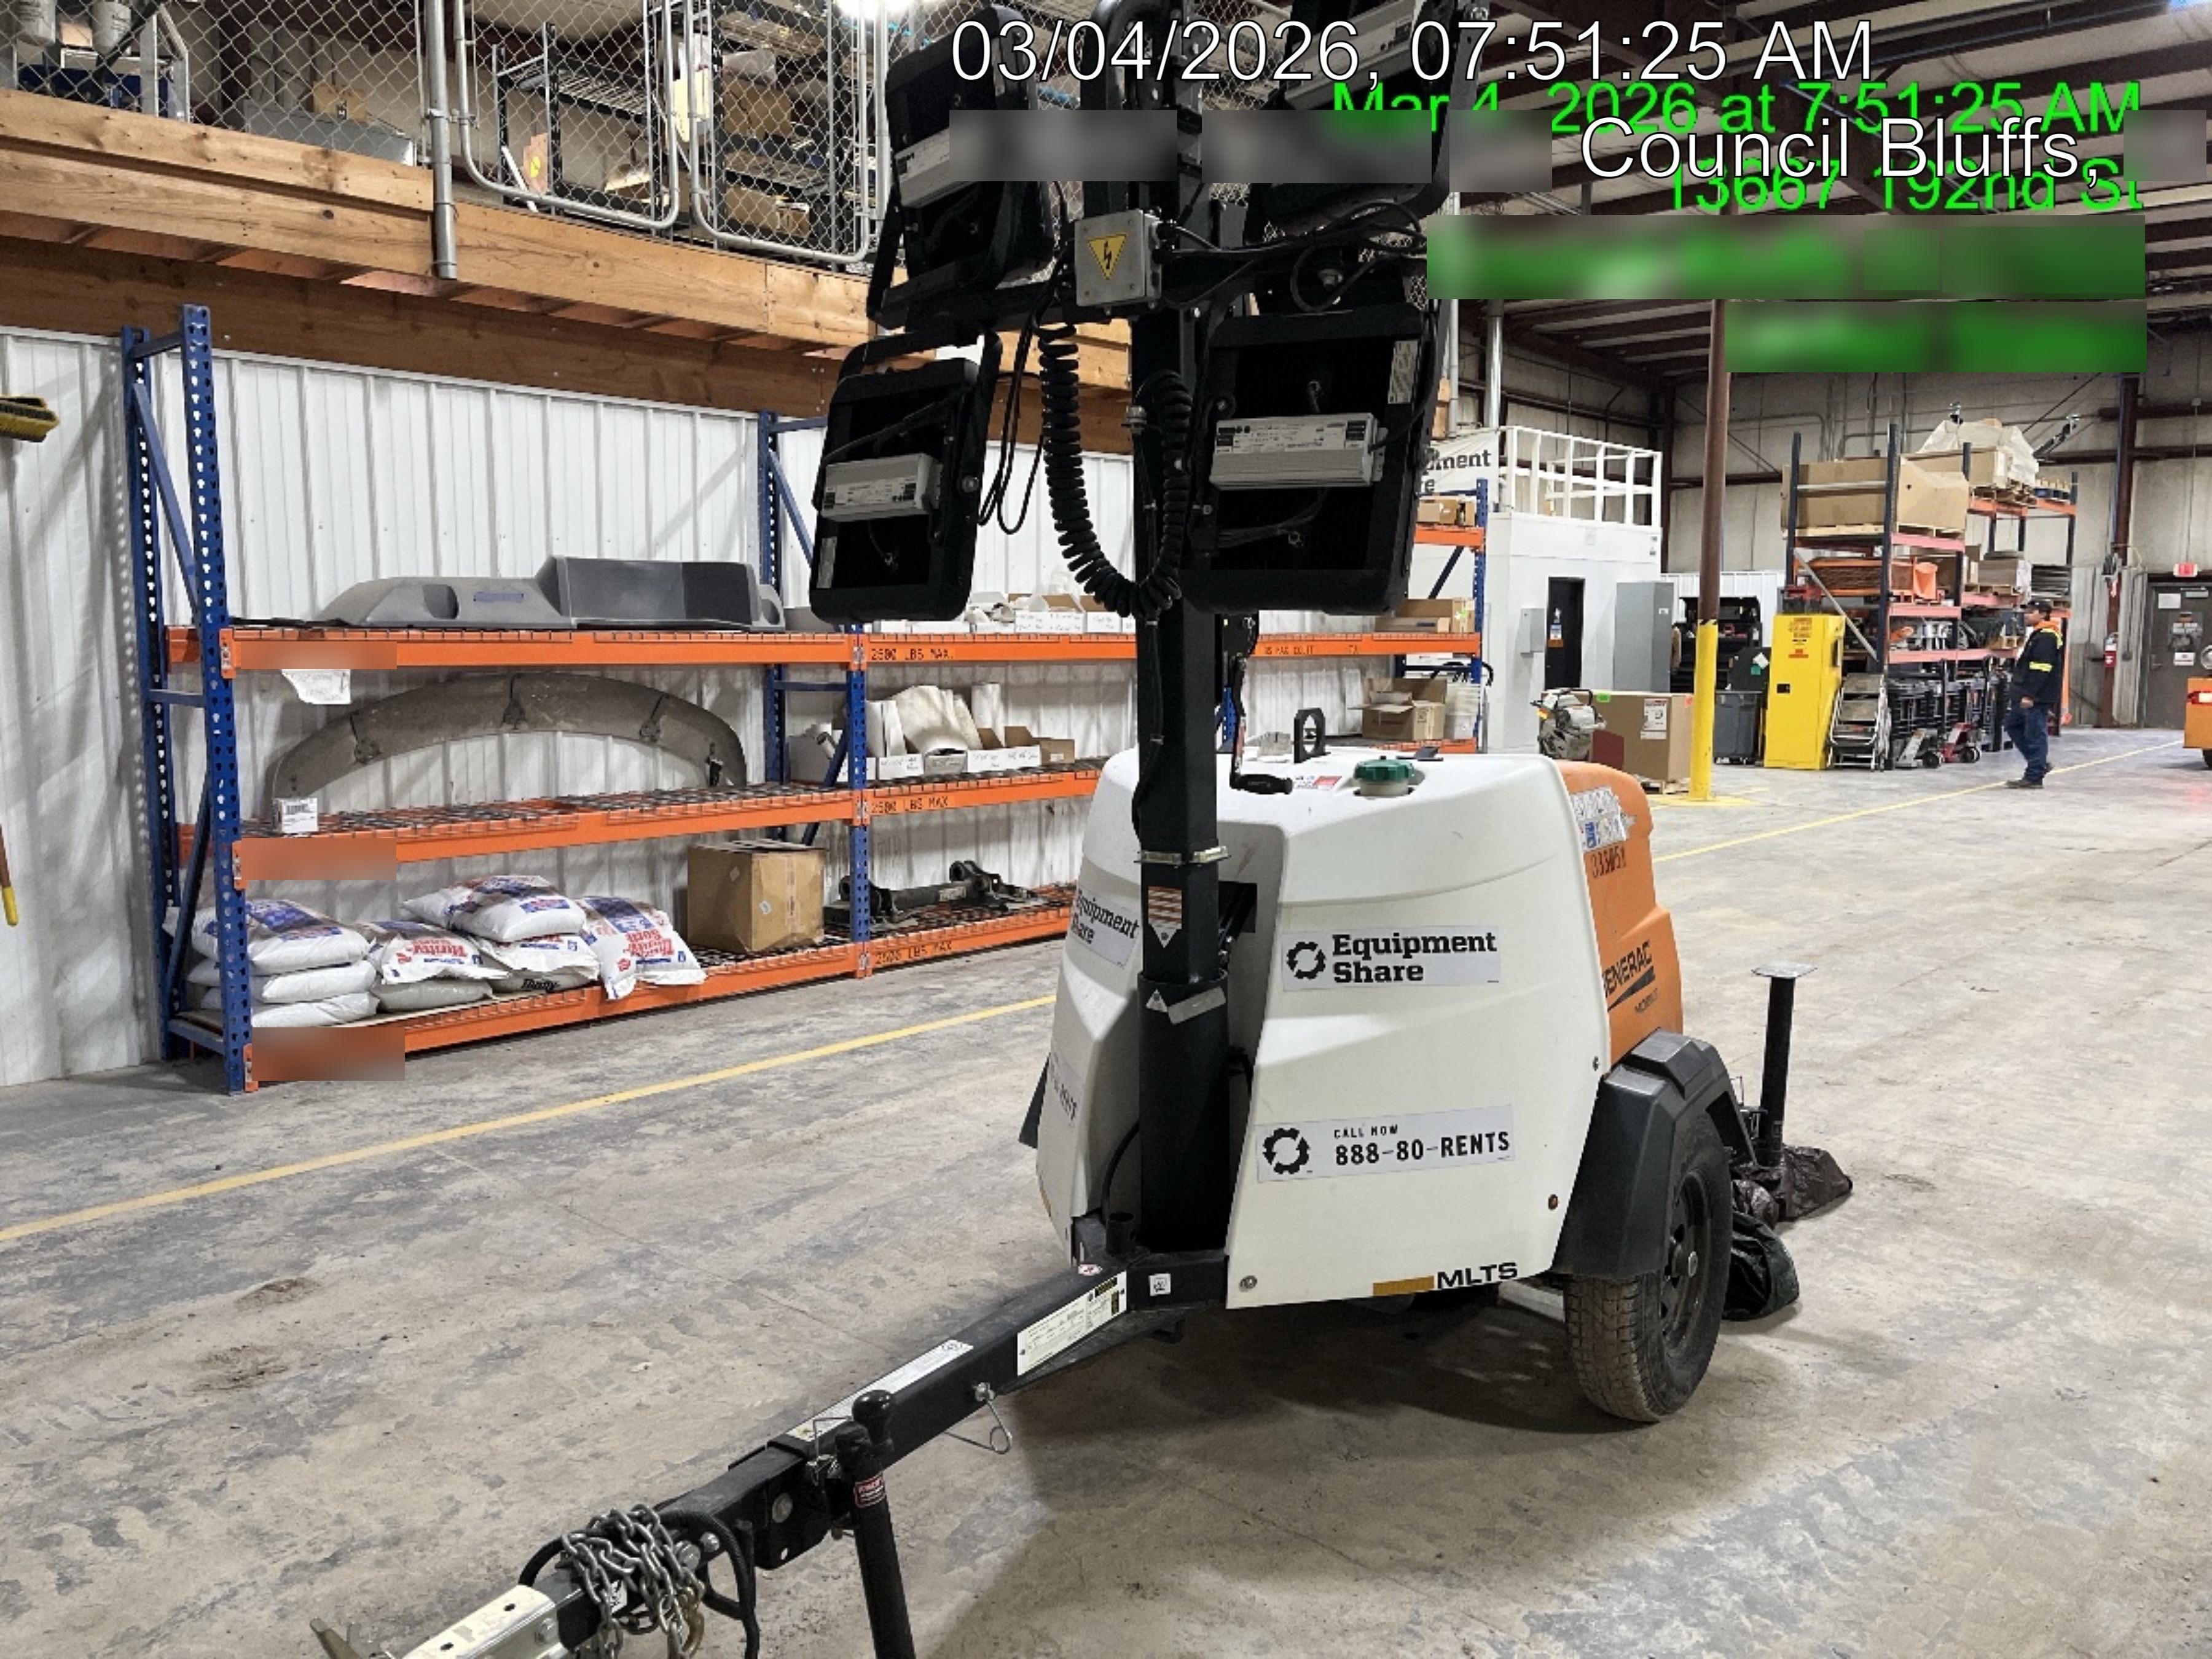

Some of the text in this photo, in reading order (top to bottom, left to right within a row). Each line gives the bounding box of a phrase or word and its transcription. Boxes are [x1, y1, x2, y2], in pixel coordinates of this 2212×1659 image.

[1331, 931, 1498, 961] Equipment
[1332, 962, 1424, 984] Share
[1602, 939, 1653, 998] ENERAC
[1333, 1124, 1398, 1139] CALL NOW
[1335, 1131, 1511, 1167] 888-80-RENTS
[1436, 1261, 1519, 1290] MLTS
